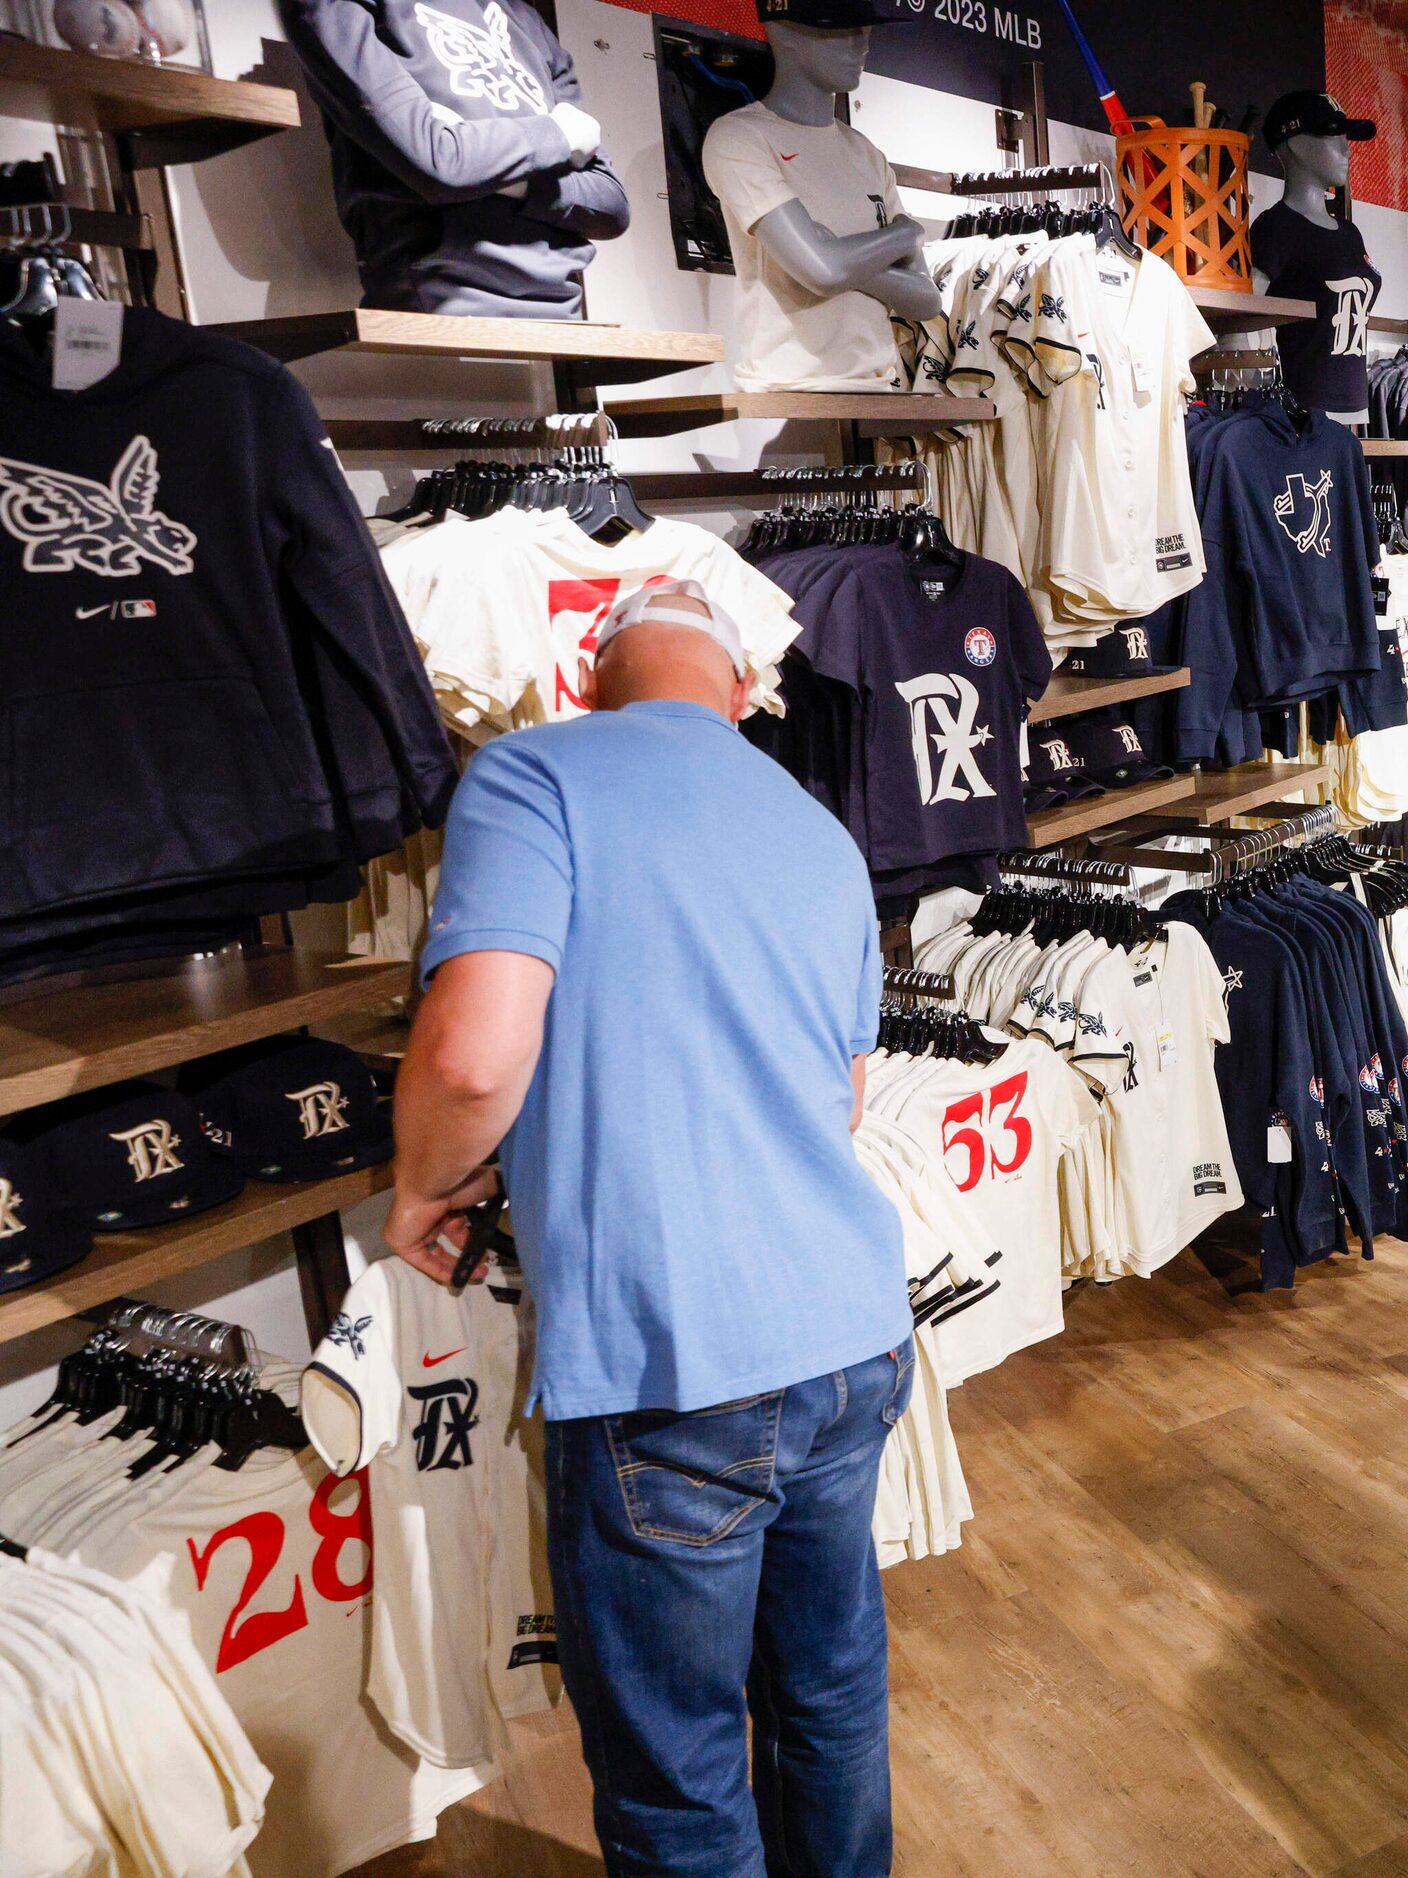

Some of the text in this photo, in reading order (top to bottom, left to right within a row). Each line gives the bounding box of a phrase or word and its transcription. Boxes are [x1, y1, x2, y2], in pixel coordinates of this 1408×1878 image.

[934, 0, 987, 32] 2023
[994, 7, 1041, 49] MLB
[974, 640, 986, 655] T
[1072, 660, 1085, 669] 21
[1073, 757, 1085, 767] 21
[211, 1128, 232, 1147] 21
[941, 1070, 1033, 1192] 53
[186, 1466, 374, 1674] 28
